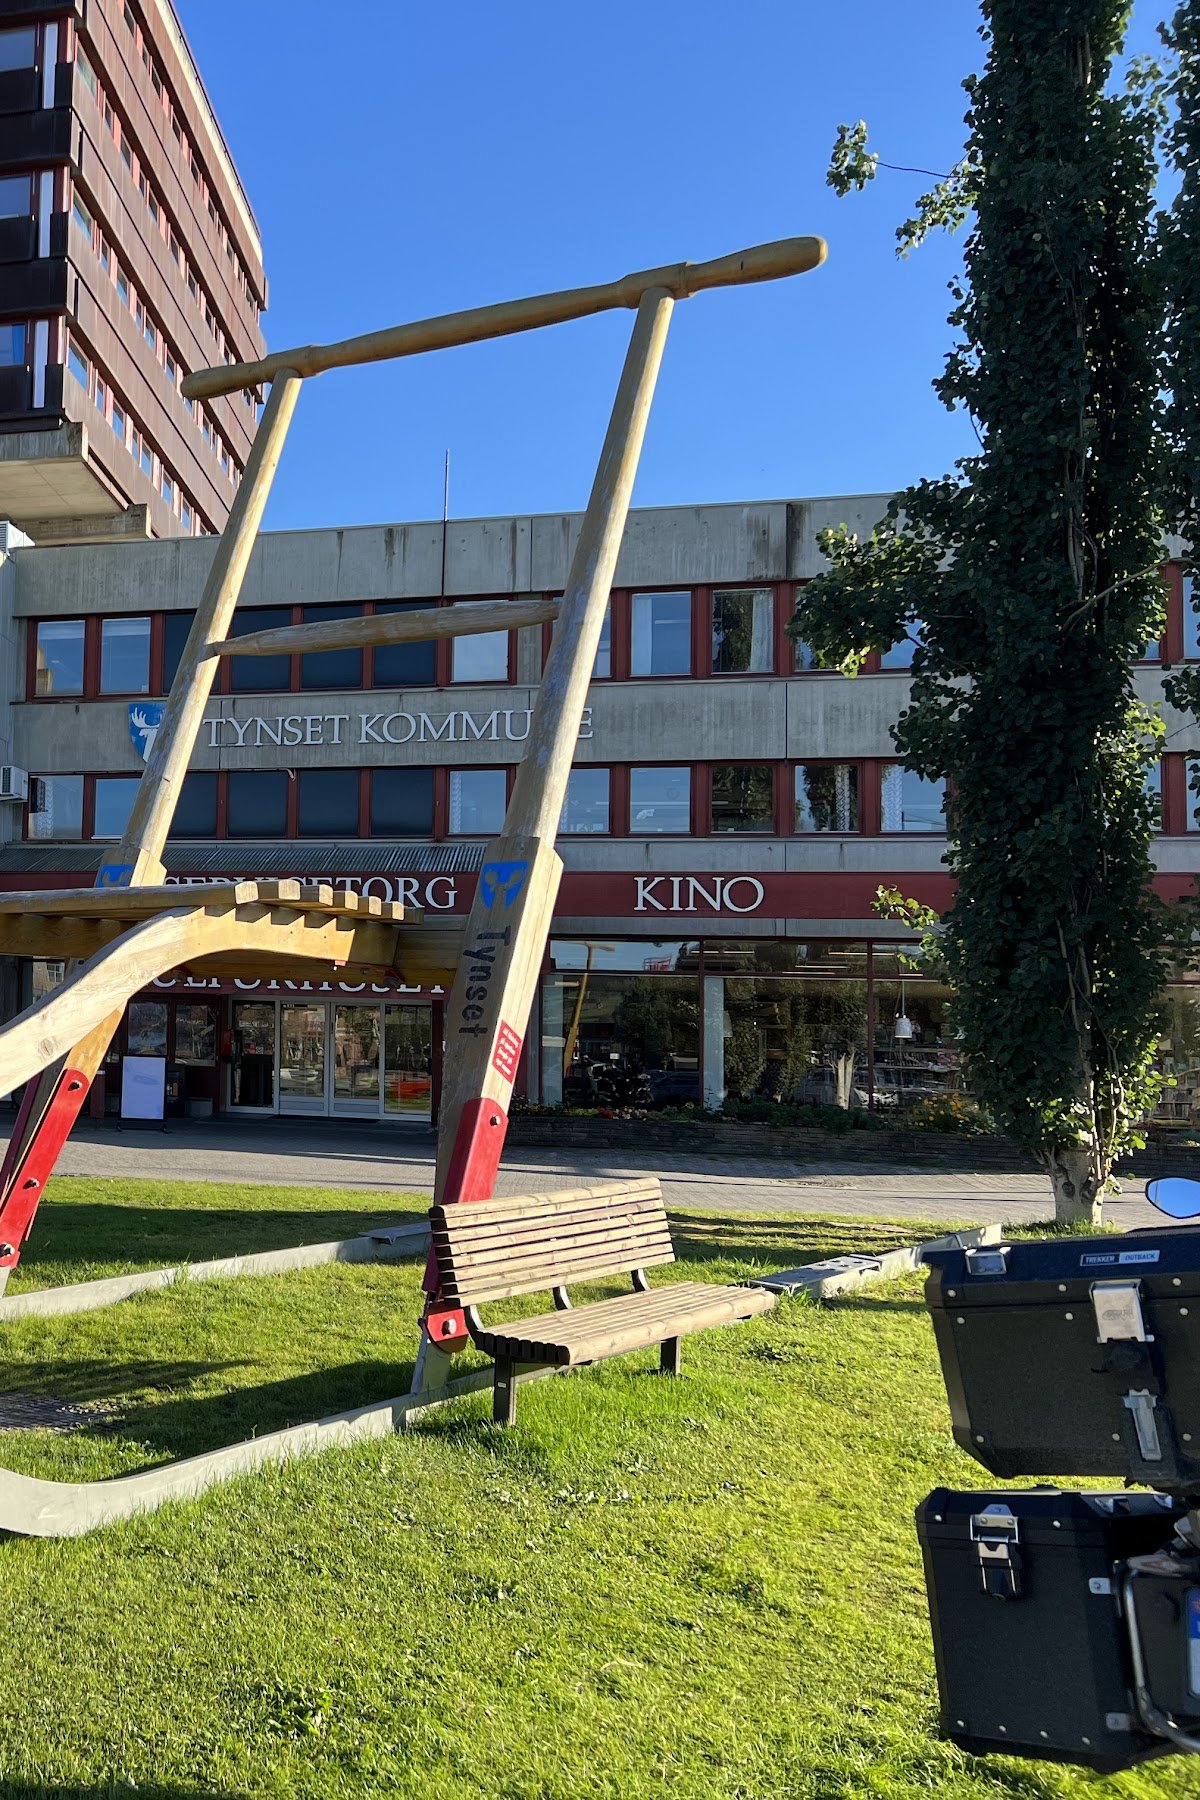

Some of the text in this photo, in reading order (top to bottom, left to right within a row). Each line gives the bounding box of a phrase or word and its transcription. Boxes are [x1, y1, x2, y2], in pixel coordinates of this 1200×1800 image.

[202, 706, 594, 748] TYNSET KOMMUE
[633, 876, 765, 913] KINO
[462, 924, 512, 1039] Tynset
[1084, 1253, 1156, 1264] TREKKER OUTBACK
